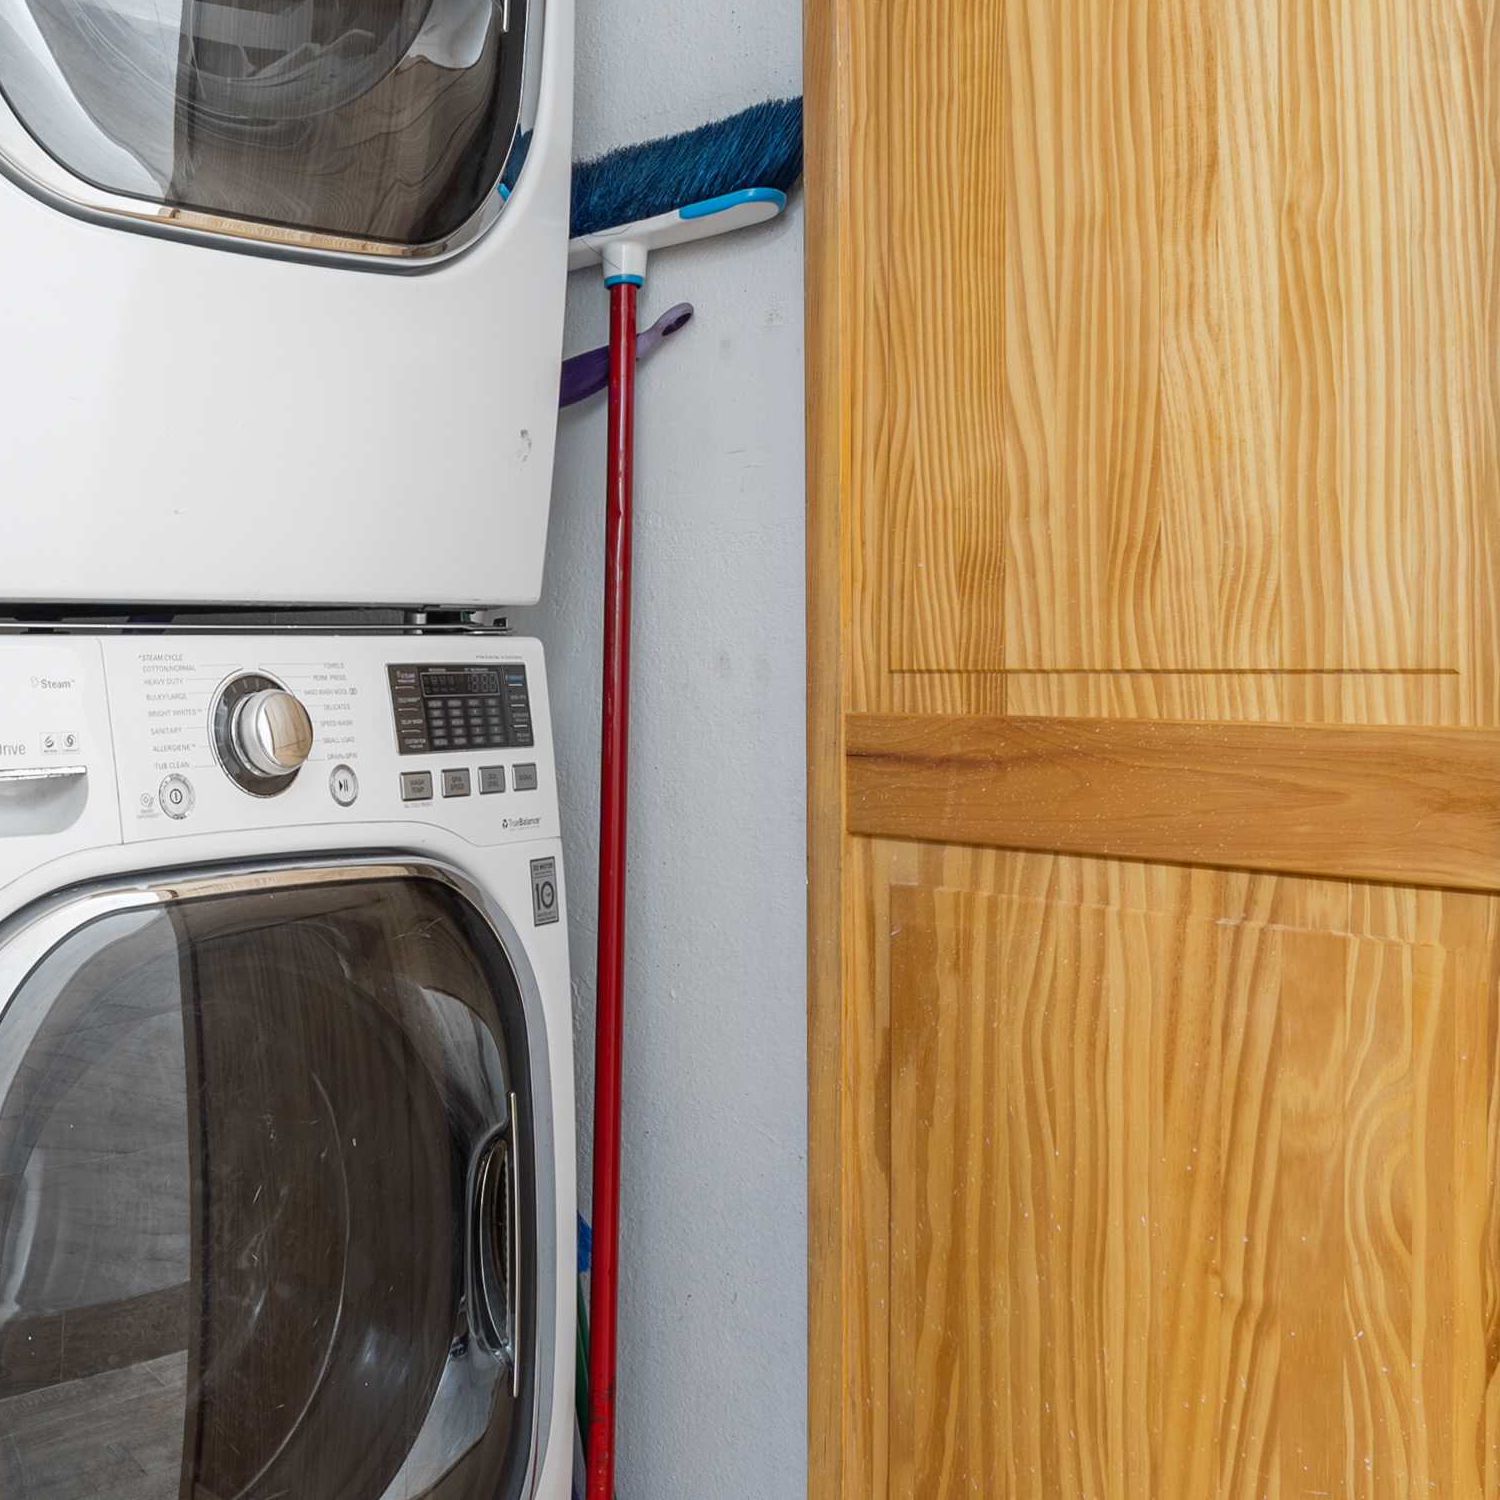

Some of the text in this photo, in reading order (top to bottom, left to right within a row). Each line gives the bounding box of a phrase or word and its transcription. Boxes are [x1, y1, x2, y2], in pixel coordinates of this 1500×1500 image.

[143, 665, 197, 673] COTTON/NORMAL
[146, 692, 187, 701] BULKY/LARGE
[150, 727, 182, 735] SANITARY
[155, 762, 168, 770] TUB
[411, 786, 425, 794] TEMP
[450, 783, 464, 791] SPEED
[535, 881, 554, 911] 10
